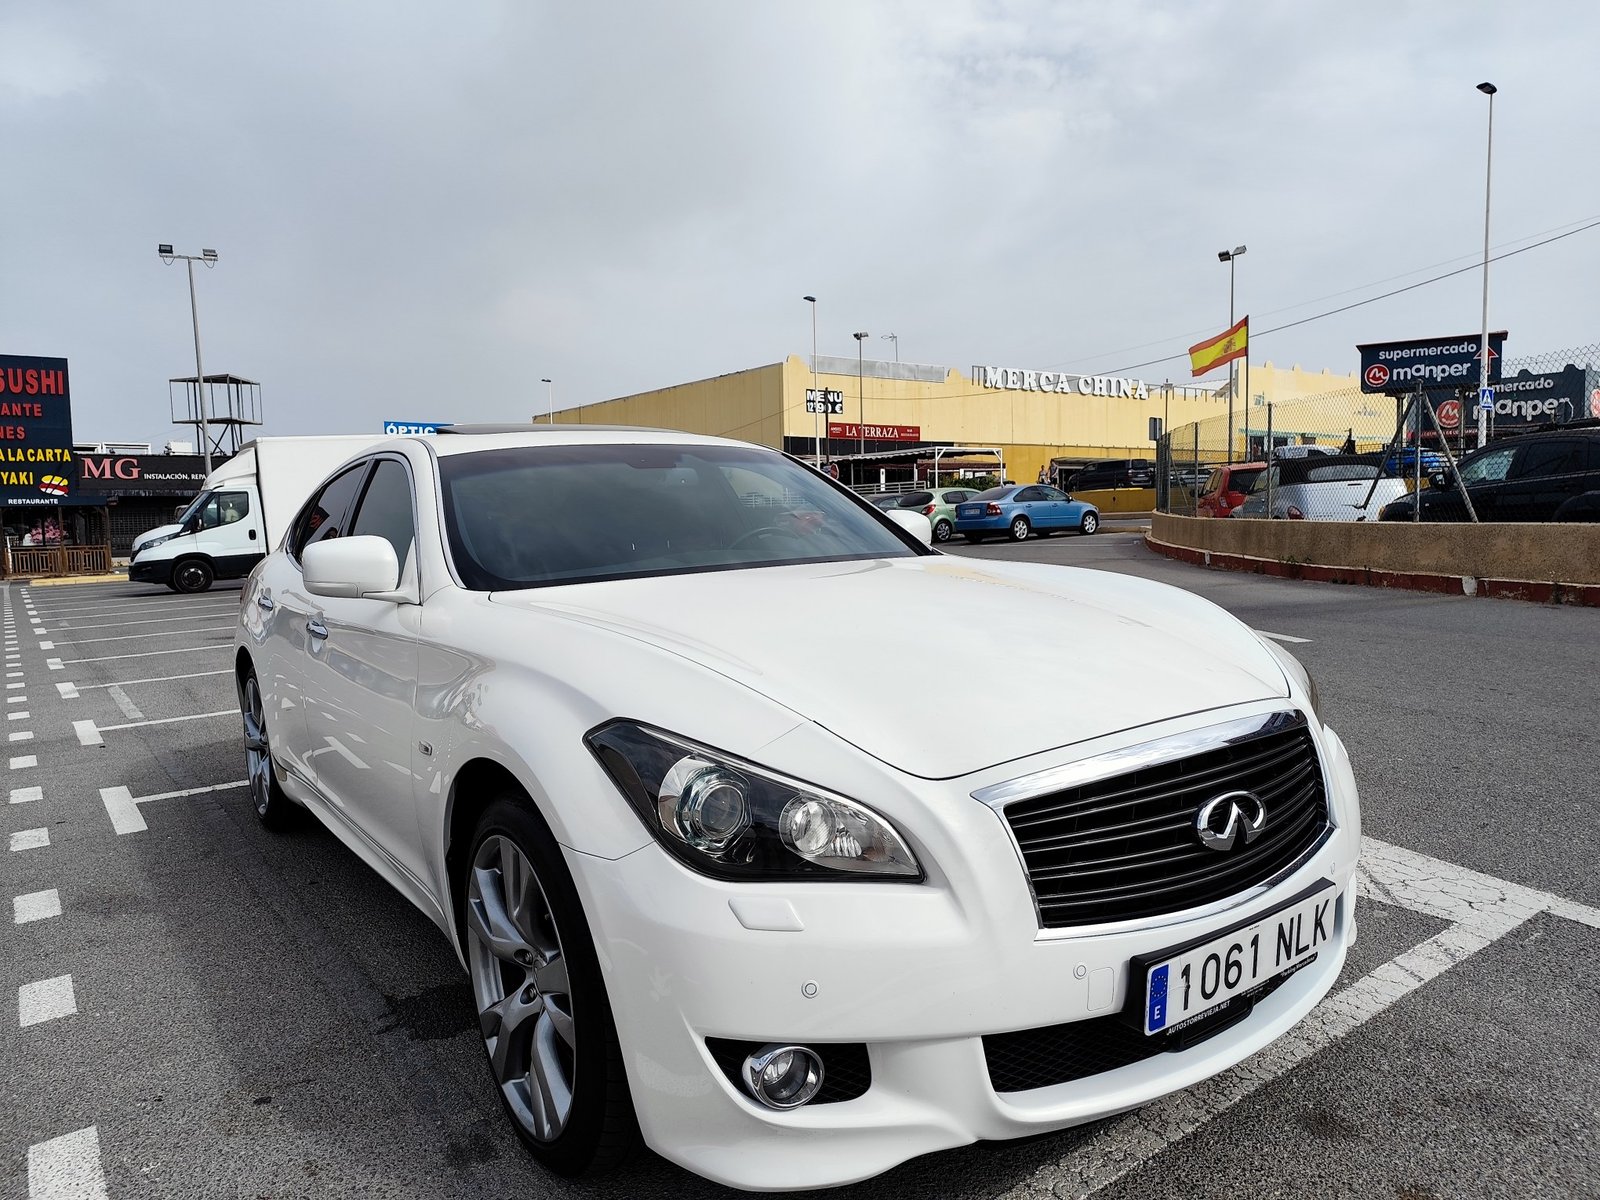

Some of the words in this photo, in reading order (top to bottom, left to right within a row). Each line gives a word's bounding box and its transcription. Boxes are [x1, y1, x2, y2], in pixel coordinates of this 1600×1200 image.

[1378, 341, 1477, 361] supermercado
[1392, 362, 1471, 382] manper
[983, 366, 1071, 393] MERCA
[1077, 374, 1149, 400] CHINA
[1, 402, 42, 417] ANTE
[846, 425, 857, 437] LA
[7, 448, 25, 461] LA
[27, 449, 72, 462] CARTA
[1, 471, 34, 485] YAKI
[81, 457, 141, 479] MG
[1154, 1005, 1161, 1020] E
[1181, 933, 1260, 1011] 1061
[1275, 898, 1330, 967] NLK
